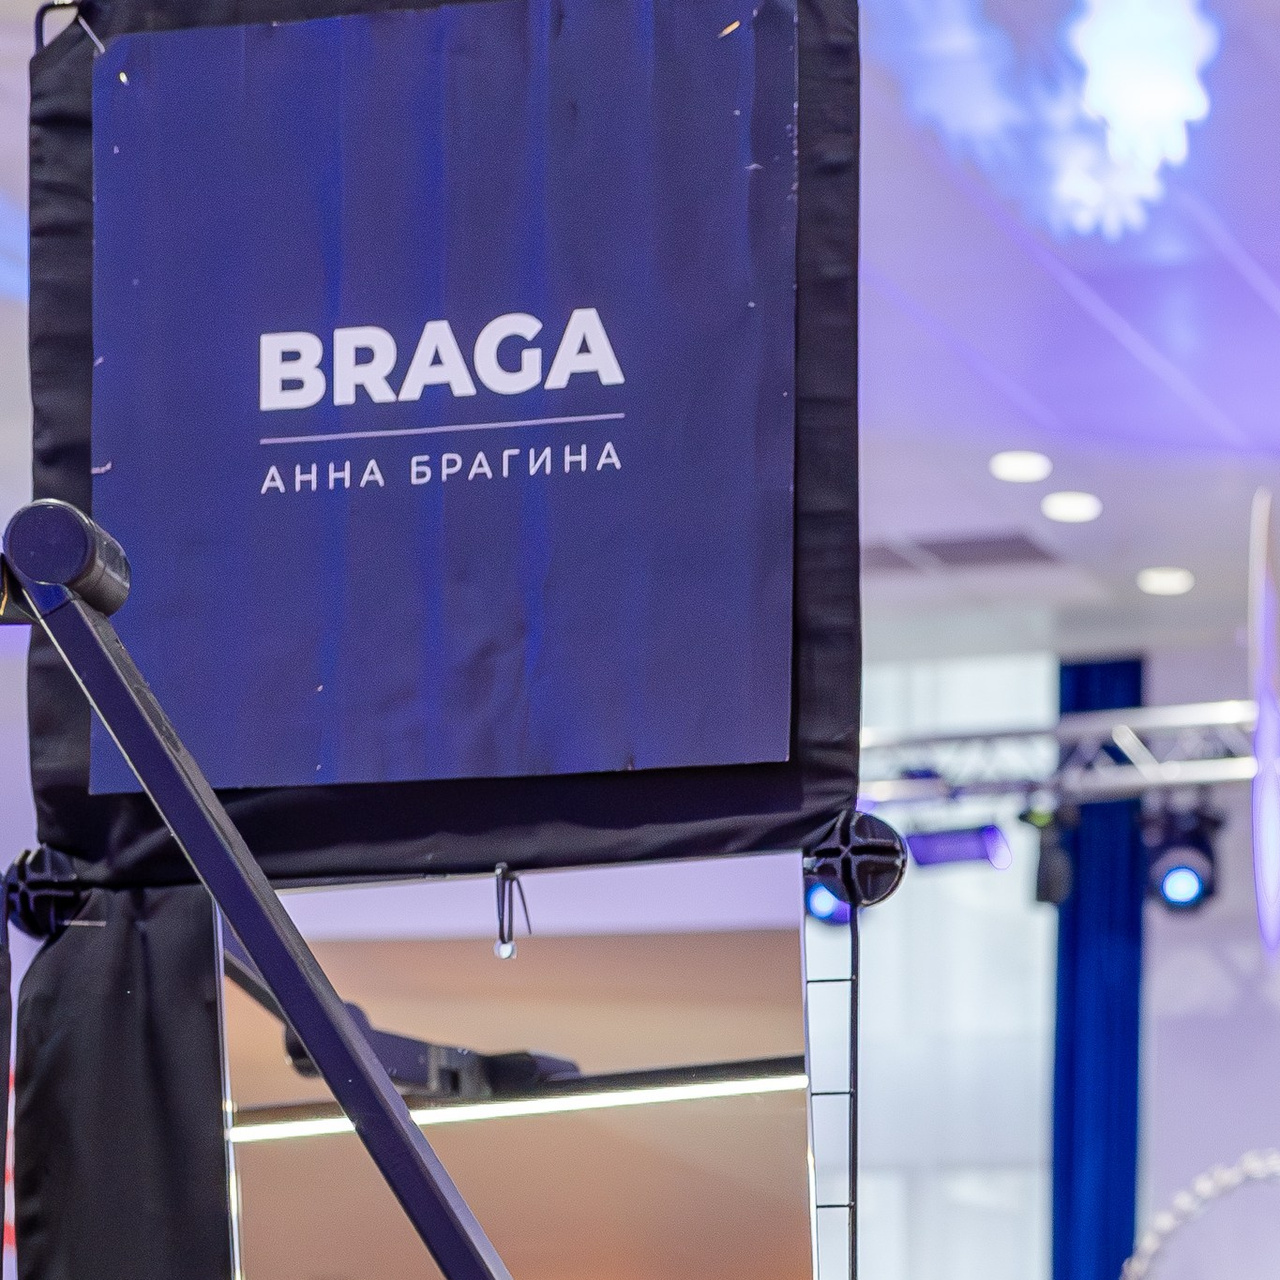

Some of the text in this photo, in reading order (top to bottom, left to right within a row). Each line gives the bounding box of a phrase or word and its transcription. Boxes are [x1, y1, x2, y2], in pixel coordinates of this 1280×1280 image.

[259, 307, 626, 412] BRAGA
[260, 441, 623, 495] АННА БРАГИНА
